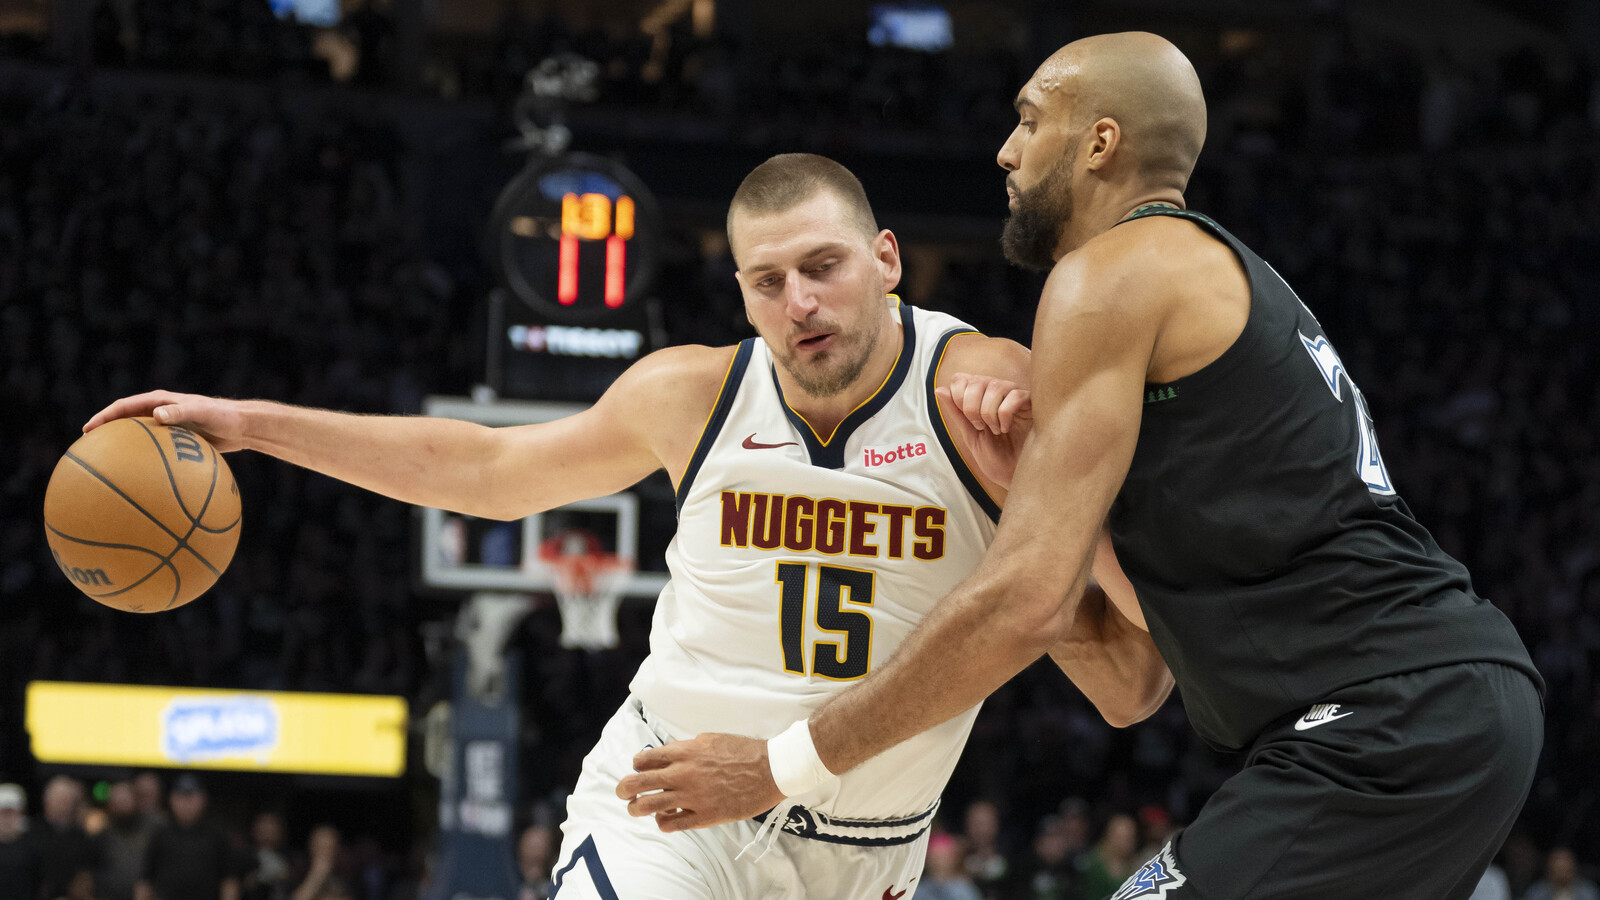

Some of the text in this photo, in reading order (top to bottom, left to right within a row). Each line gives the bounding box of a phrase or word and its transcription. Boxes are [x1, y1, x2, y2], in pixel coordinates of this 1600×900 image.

[557, 234, 626, 309] 11
[864, 442, 927, 468] ibotta
[720, 490, 947, 561] NUGGETS
[775, 560, 876, 681] 15
[1304, 703, 1341, 720] NIKE
